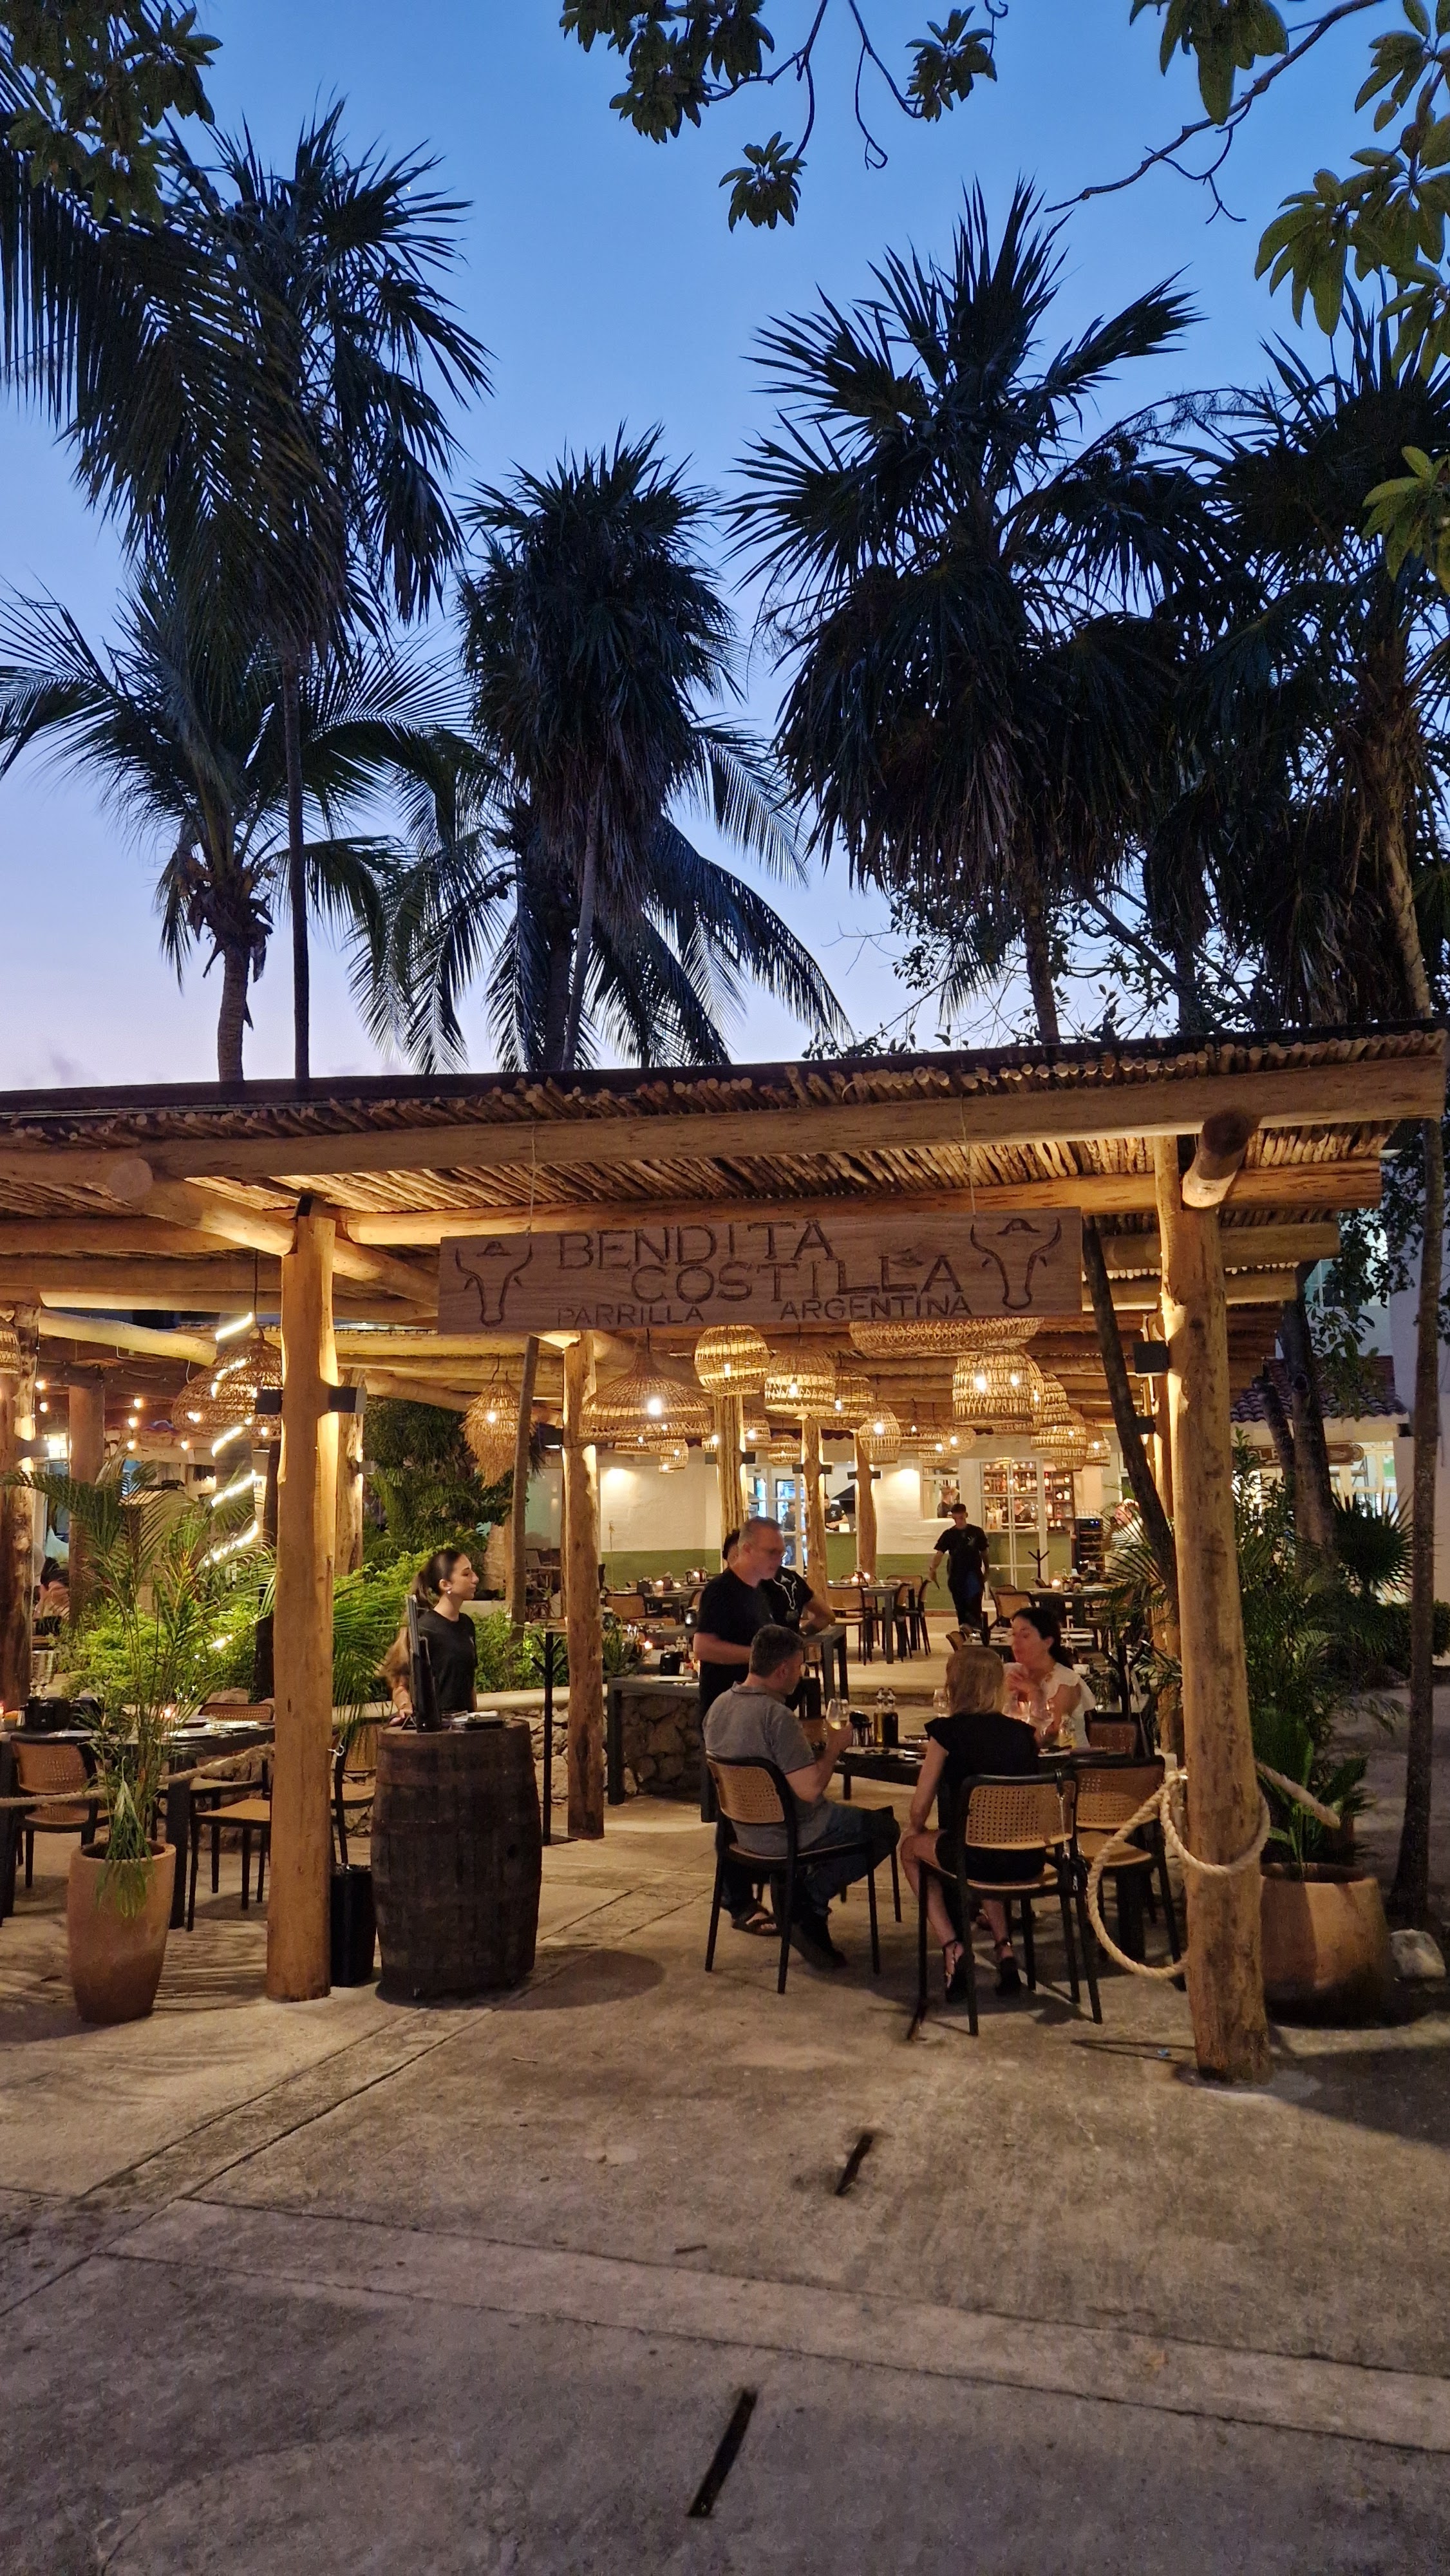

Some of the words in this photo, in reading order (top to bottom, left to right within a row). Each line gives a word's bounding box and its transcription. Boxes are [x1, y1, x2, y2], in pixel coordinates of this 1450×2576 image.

[557, 1220, 837, 1269] BENDITA
[631, 1255, 963, 1304] COSTILLA
[558, 1303, 704, 1327] PARRILLA
[780, 1295, 973, 1321] ARGENTINA
